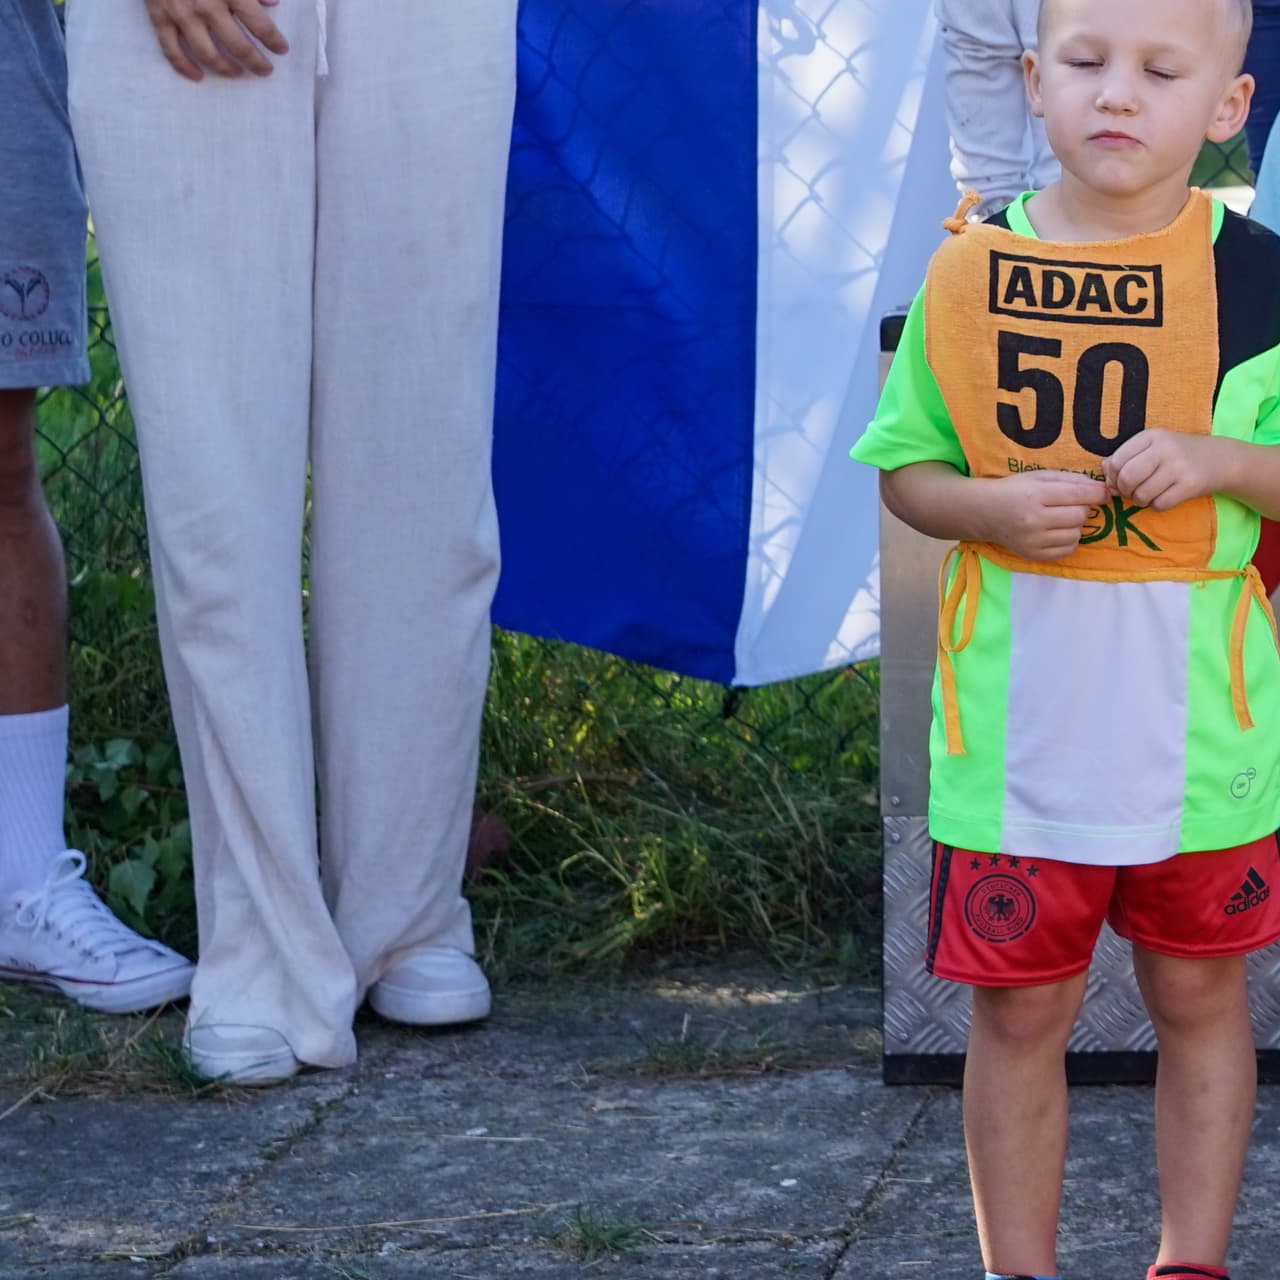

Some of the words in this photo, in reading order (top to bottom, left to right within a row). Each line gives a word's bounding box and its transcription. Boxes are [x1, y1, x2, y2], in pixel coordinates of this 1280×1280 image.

[1002, 265, 1149, 315] ADAC
[996, 329, 1150, 458] 50
[1224, 885, 1271, 916] adidas
